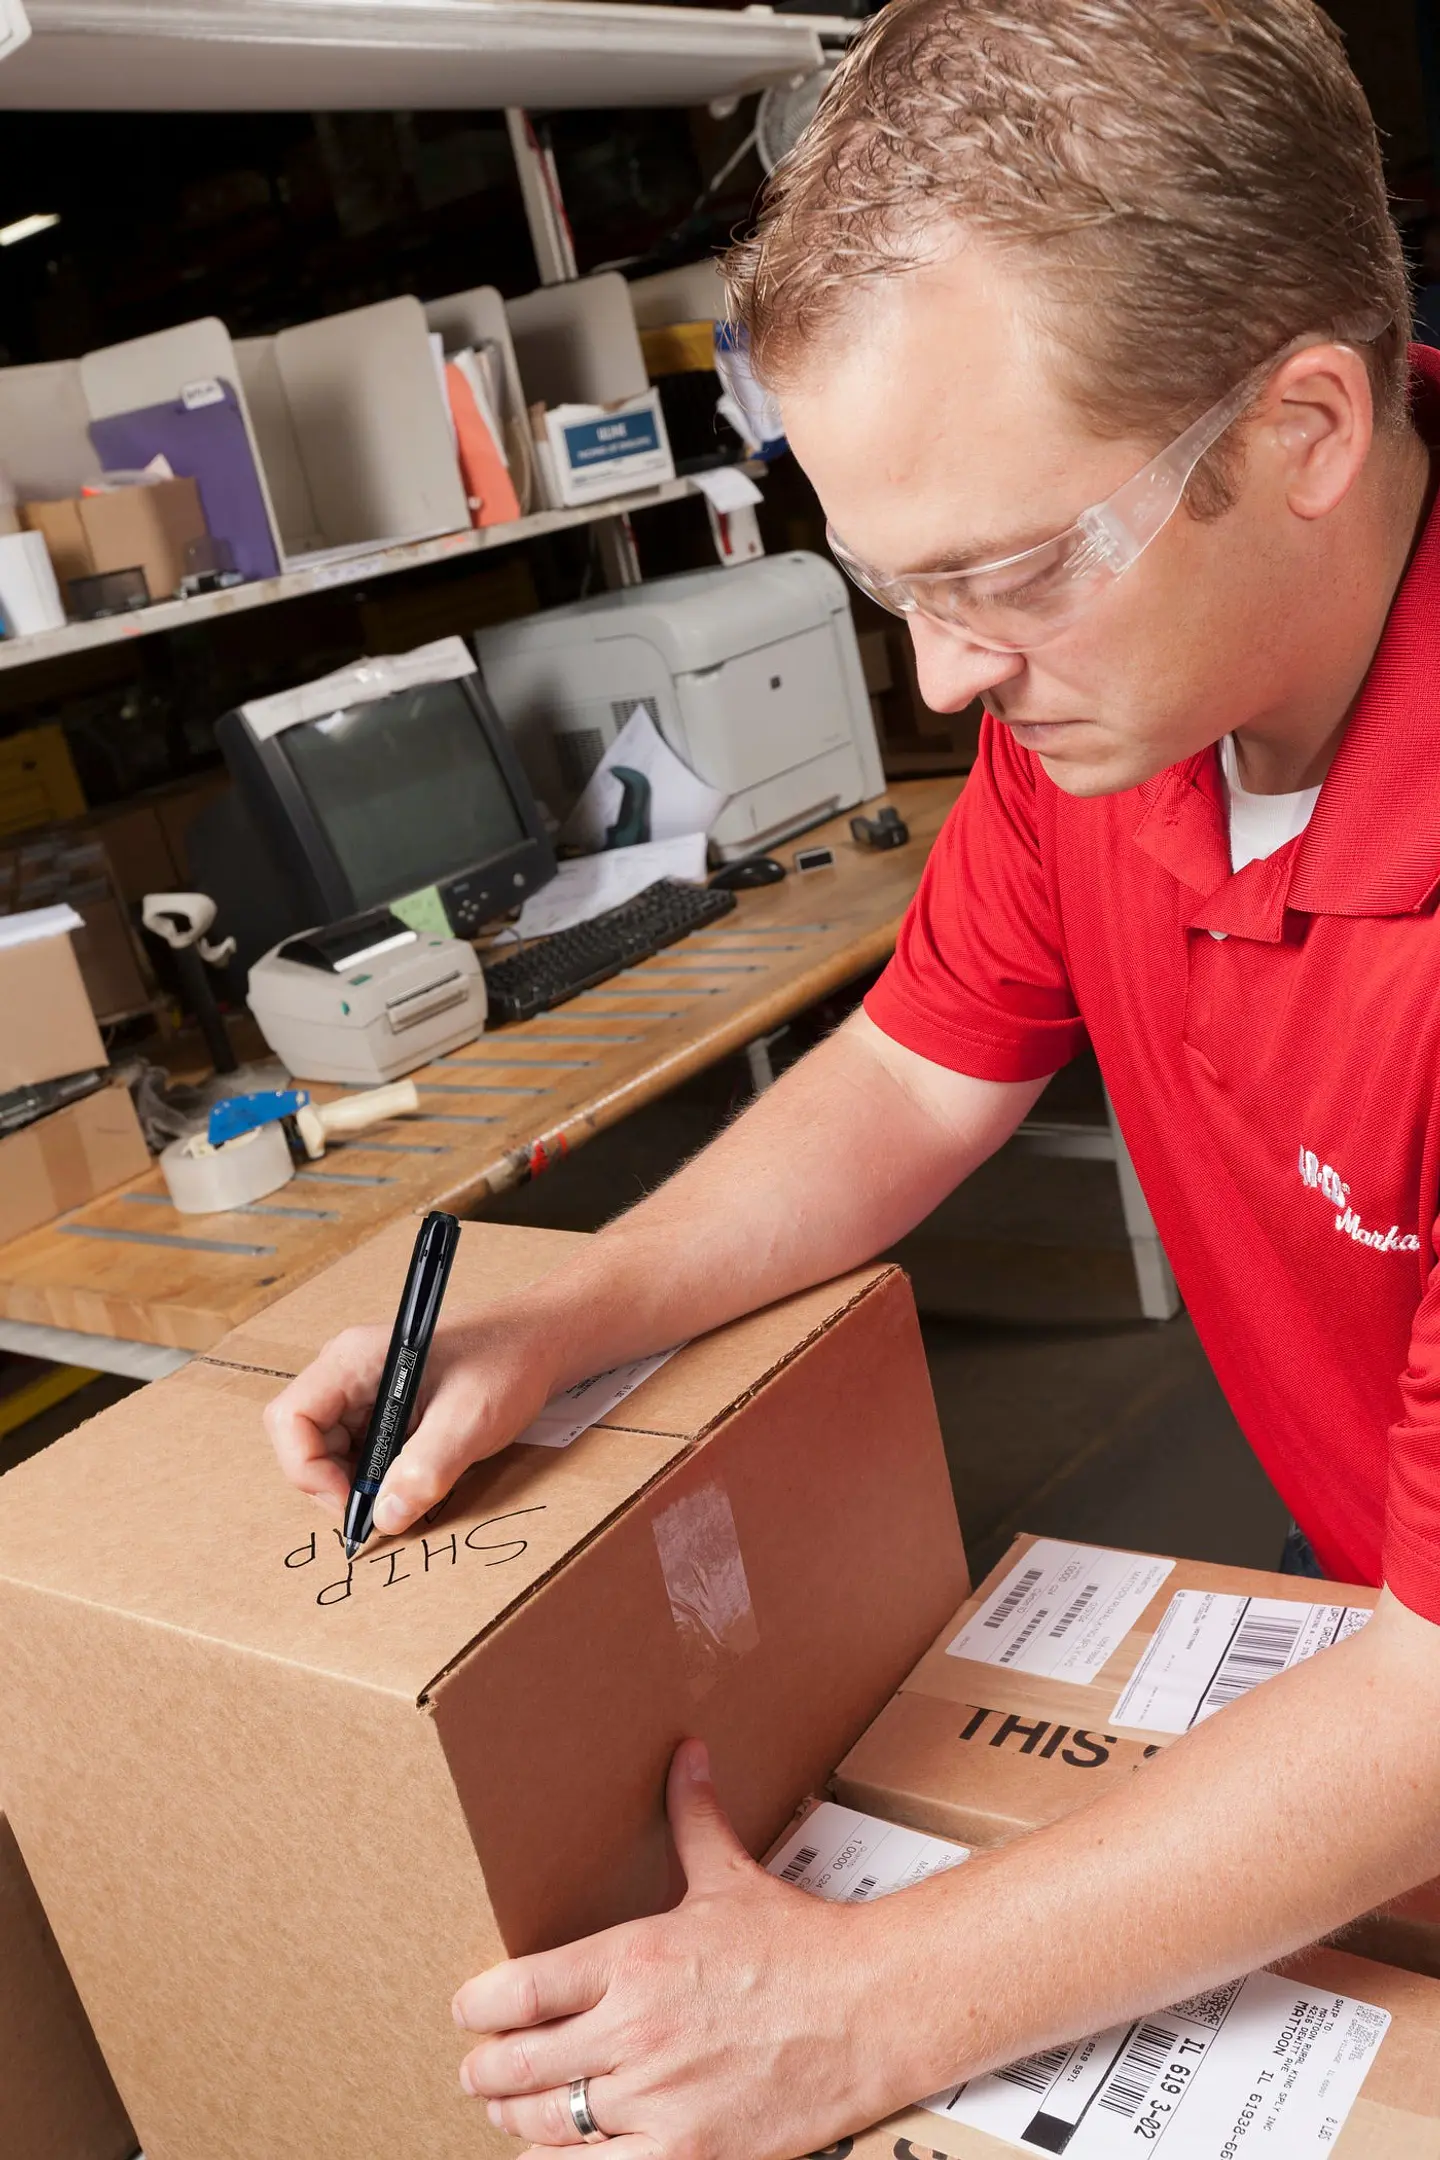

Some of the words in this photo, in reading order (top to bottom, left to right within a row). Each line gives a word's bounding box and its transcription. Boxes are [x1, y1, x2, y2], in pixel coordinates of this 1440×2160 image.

[367, 1400, 399, 1480] DURA-INK
[393, 1367, 409, 1399] RETRACTABLE
[316, 1505, 547, 1606] SHIP
[1327, 1607, 1340, 1622] UPS
[1315, 1627, 1334, 1654] GROUN
[959, 1704, 1118, 1768] THIS
[832, 1839, 863, 1871] 1.0000
[1303, 2004, 1319, 2024] 4216
[1331, 1998, 1345, 2018] SHIP
[1272, 2000, 1309, 2057] MATTOON
[1306, 2006, 1328, 2041] MATTOON
[1080, 2042, 1096, 2062] 6519
[1178, 2037, 1206, 2055] IL
[1292, 2027, 1309, 2054] DEWITT
[1280, 2057, 1294, 2073] AVE
[1293, 2041, 1311, 2067] RURAL
[1066, 2064, 1084, 2083] 5971
[1160, 2064, 1191, 2095] 619
[1256, 2069, 1275, 2085] IL
[1283, 2069, 1299, 2089] KING
[1273, 2092, 1288, 2113] SPLY
[1133, 2099, 1172, 2140] 3-02
[1219, 2093, 1263, 2160] 61938-66
[1263, 2115, 1277, 2132] INC
[1318, 2125, 1335, 2142] LBS
